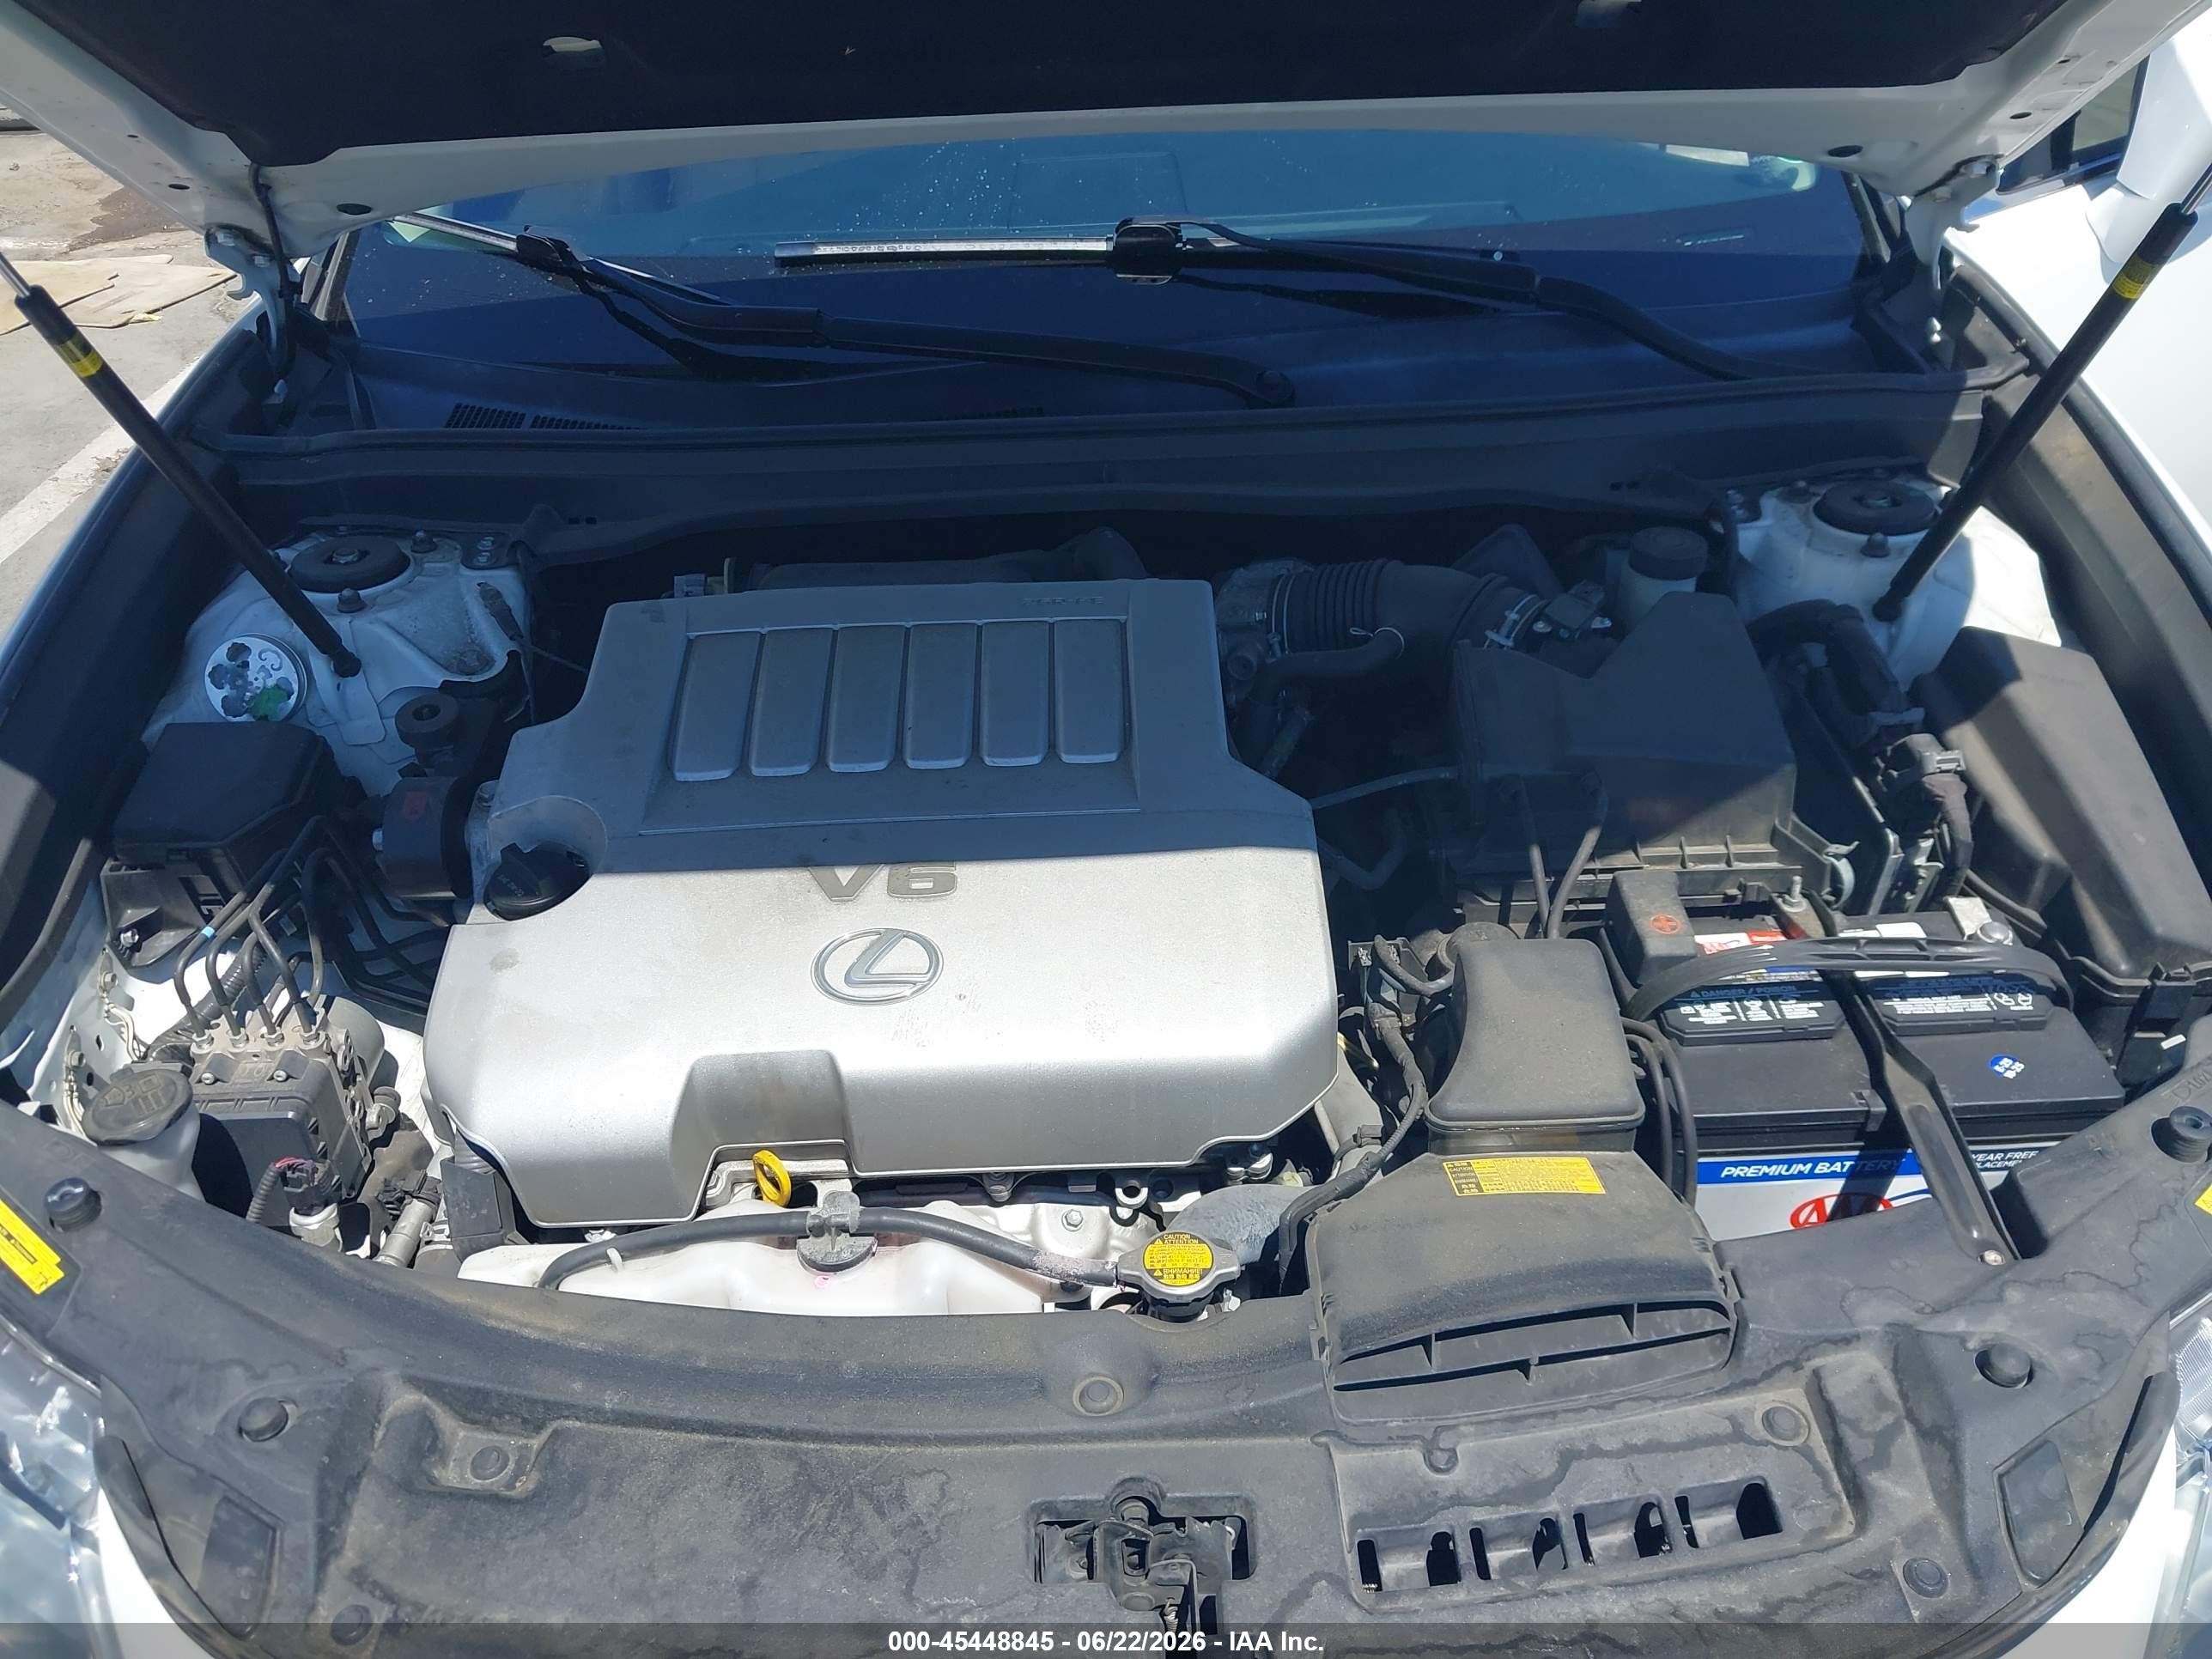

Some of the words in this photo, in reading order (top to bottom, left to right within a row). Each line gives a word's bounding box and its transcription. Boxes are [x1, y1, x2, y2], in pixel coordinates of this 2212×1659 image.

[805, 861, 959, 902] V6
[1700, 988, 1746, 998] DANGER
[1755, 985, 1796, 994] POISON
[1720, 1162, 1813, 1178] PREMIUM
[1814, 1157, 1905, 1175] BATTERY
